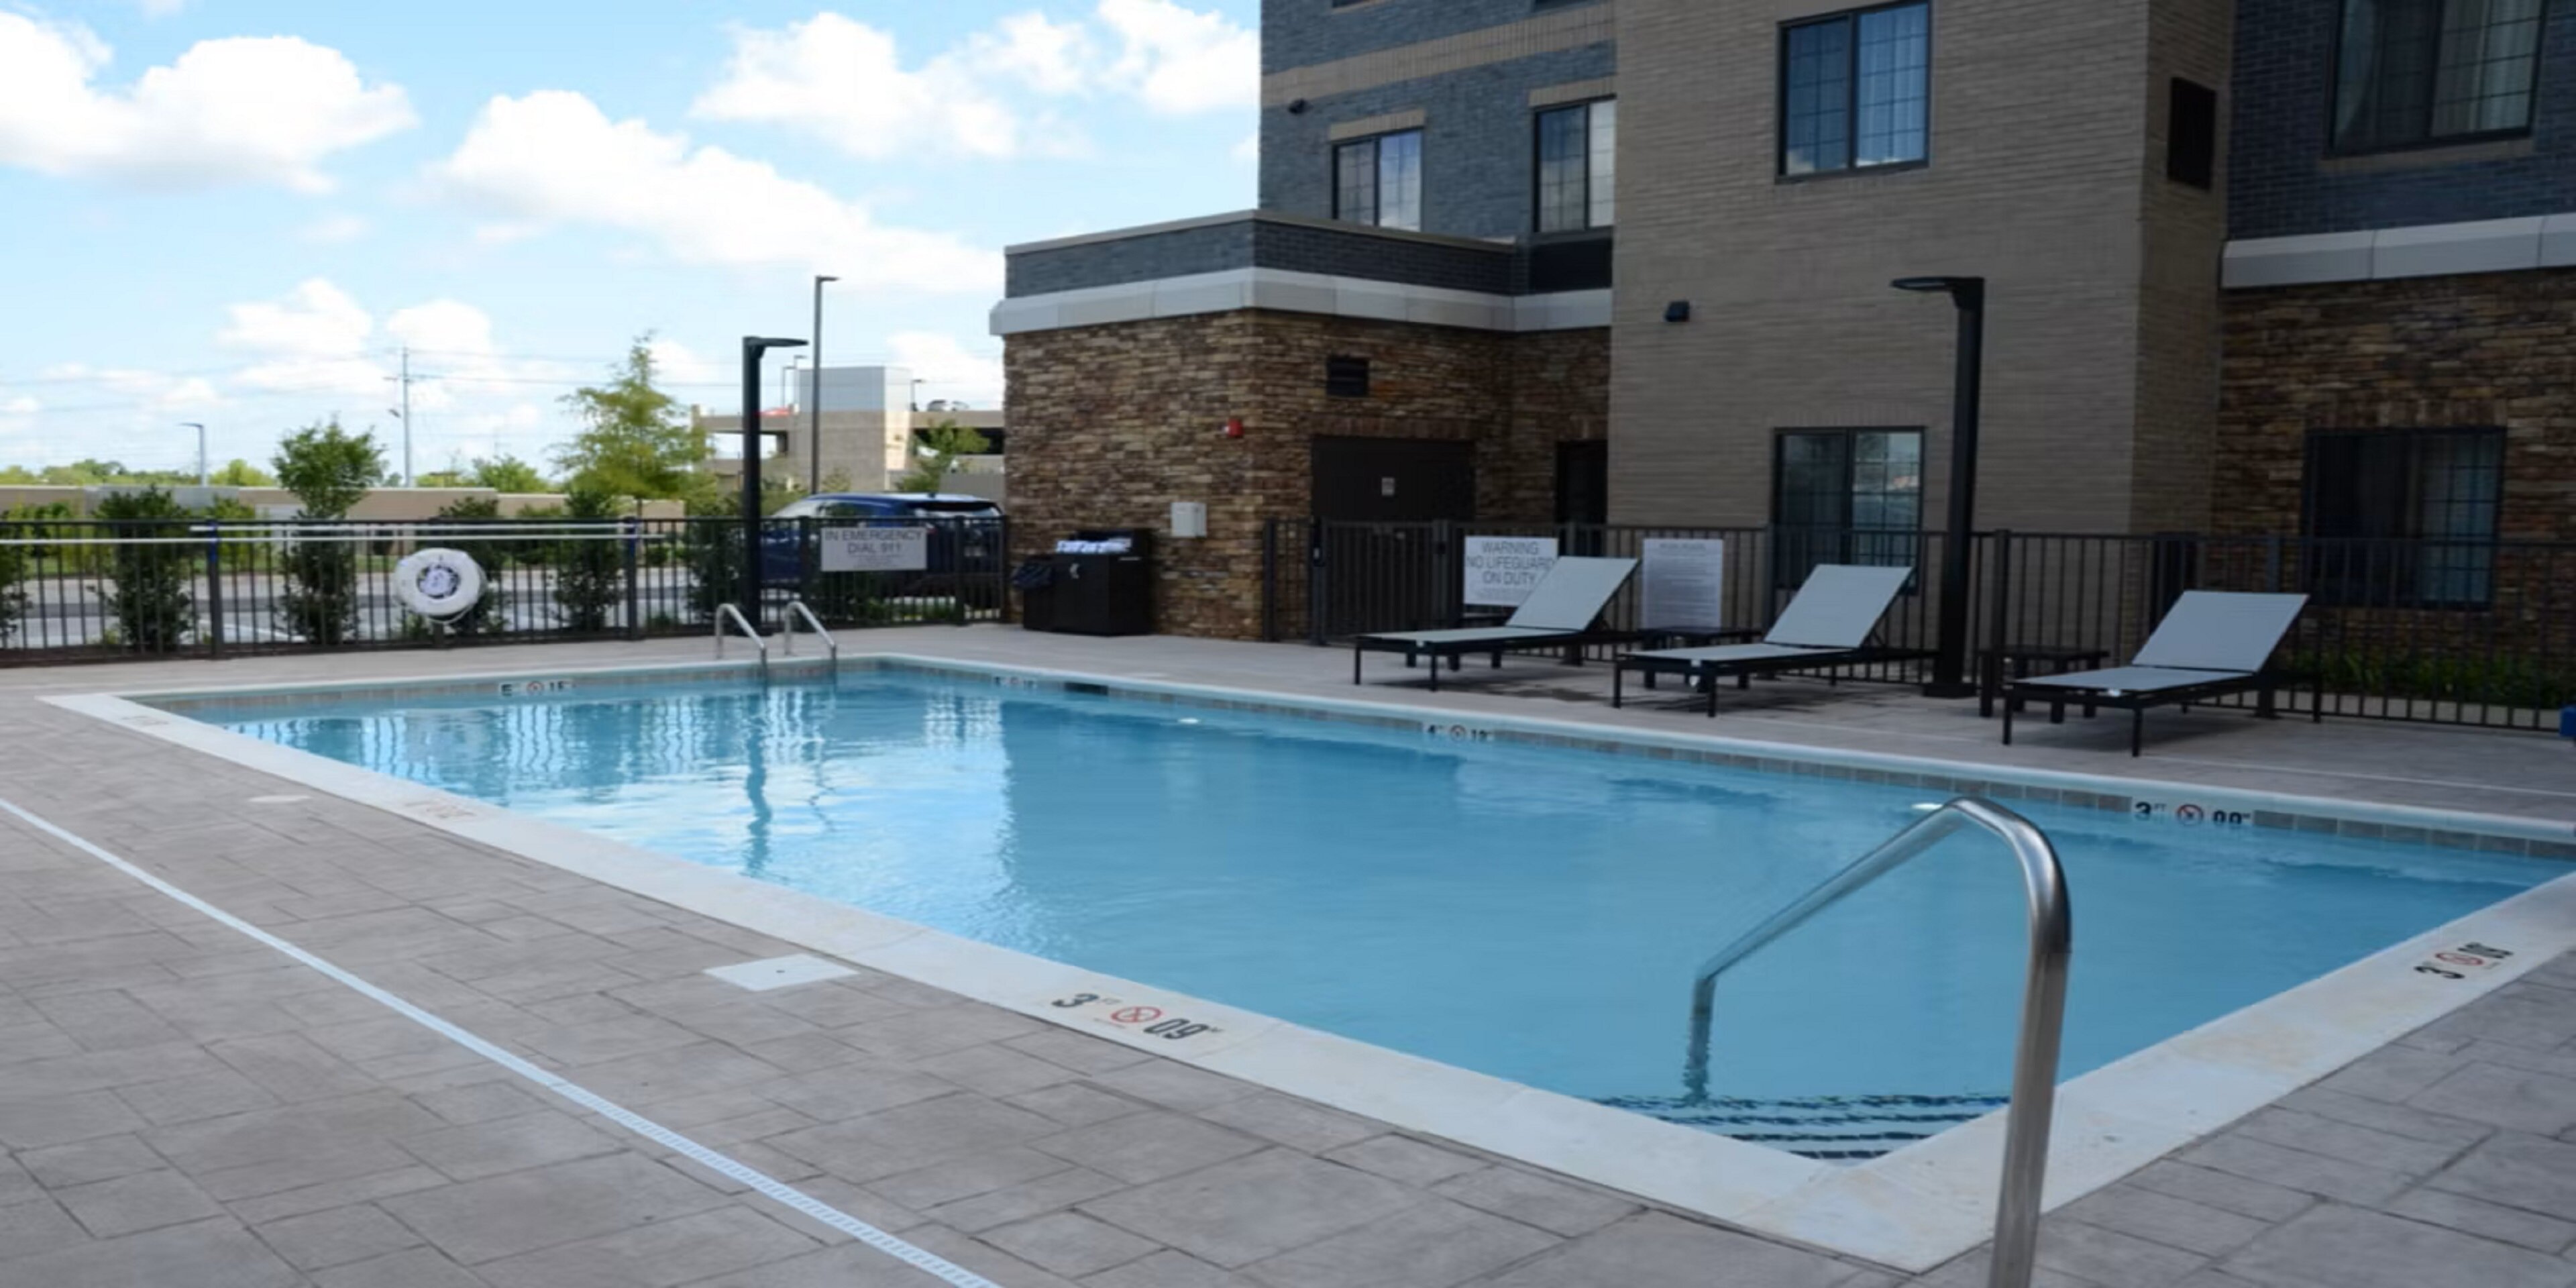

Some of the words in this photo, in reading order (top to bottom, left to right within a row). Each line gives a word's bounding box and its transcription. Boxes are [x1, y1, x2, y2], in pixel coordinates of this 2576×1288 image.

[824, 530, 839, 541] IN
[842, 529, 922, 541] EMERGENCY
[847, 543, 875, 554] DIAL
[881, 543, 901, 553] 911
[1481, 541, 1540, 555] WARNING
[1466, 555, 1483, 568] NO
[1487, 555, 1556, 570] LIFEGUARD
[1483, 571, 1501, 584] ON
[1503, 571, 1536, 585] DUTY
[1051, 993, 1099, 1008] 3
